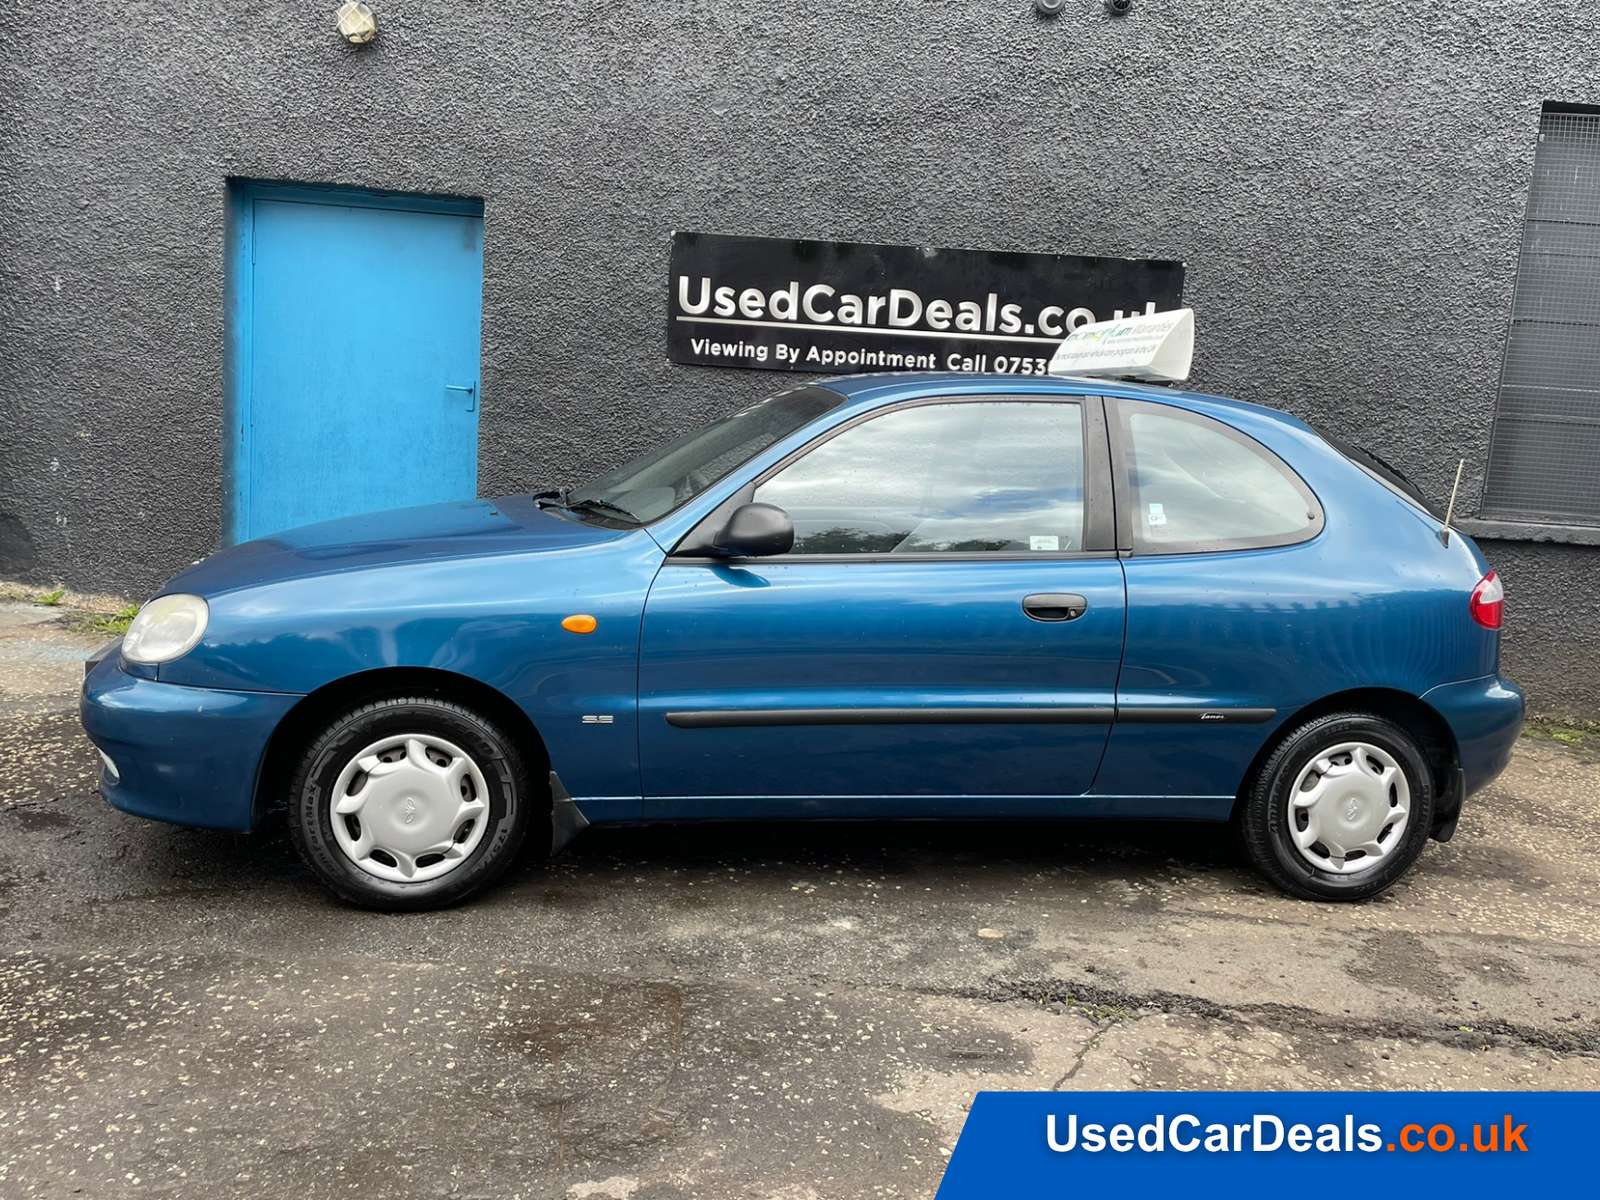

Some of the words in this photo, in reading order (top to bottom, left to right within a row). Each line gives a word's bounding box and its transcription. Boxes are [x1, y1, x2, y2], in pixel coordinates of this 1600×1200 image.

[676, 274, 1156, 336] UsedCarDeals.co
[690, 338, 768, 362] Viewing
[775, 343, 800, 363] By
[806, 345, 936, 369] Appointment
[947, 354, 986, 372] Call
